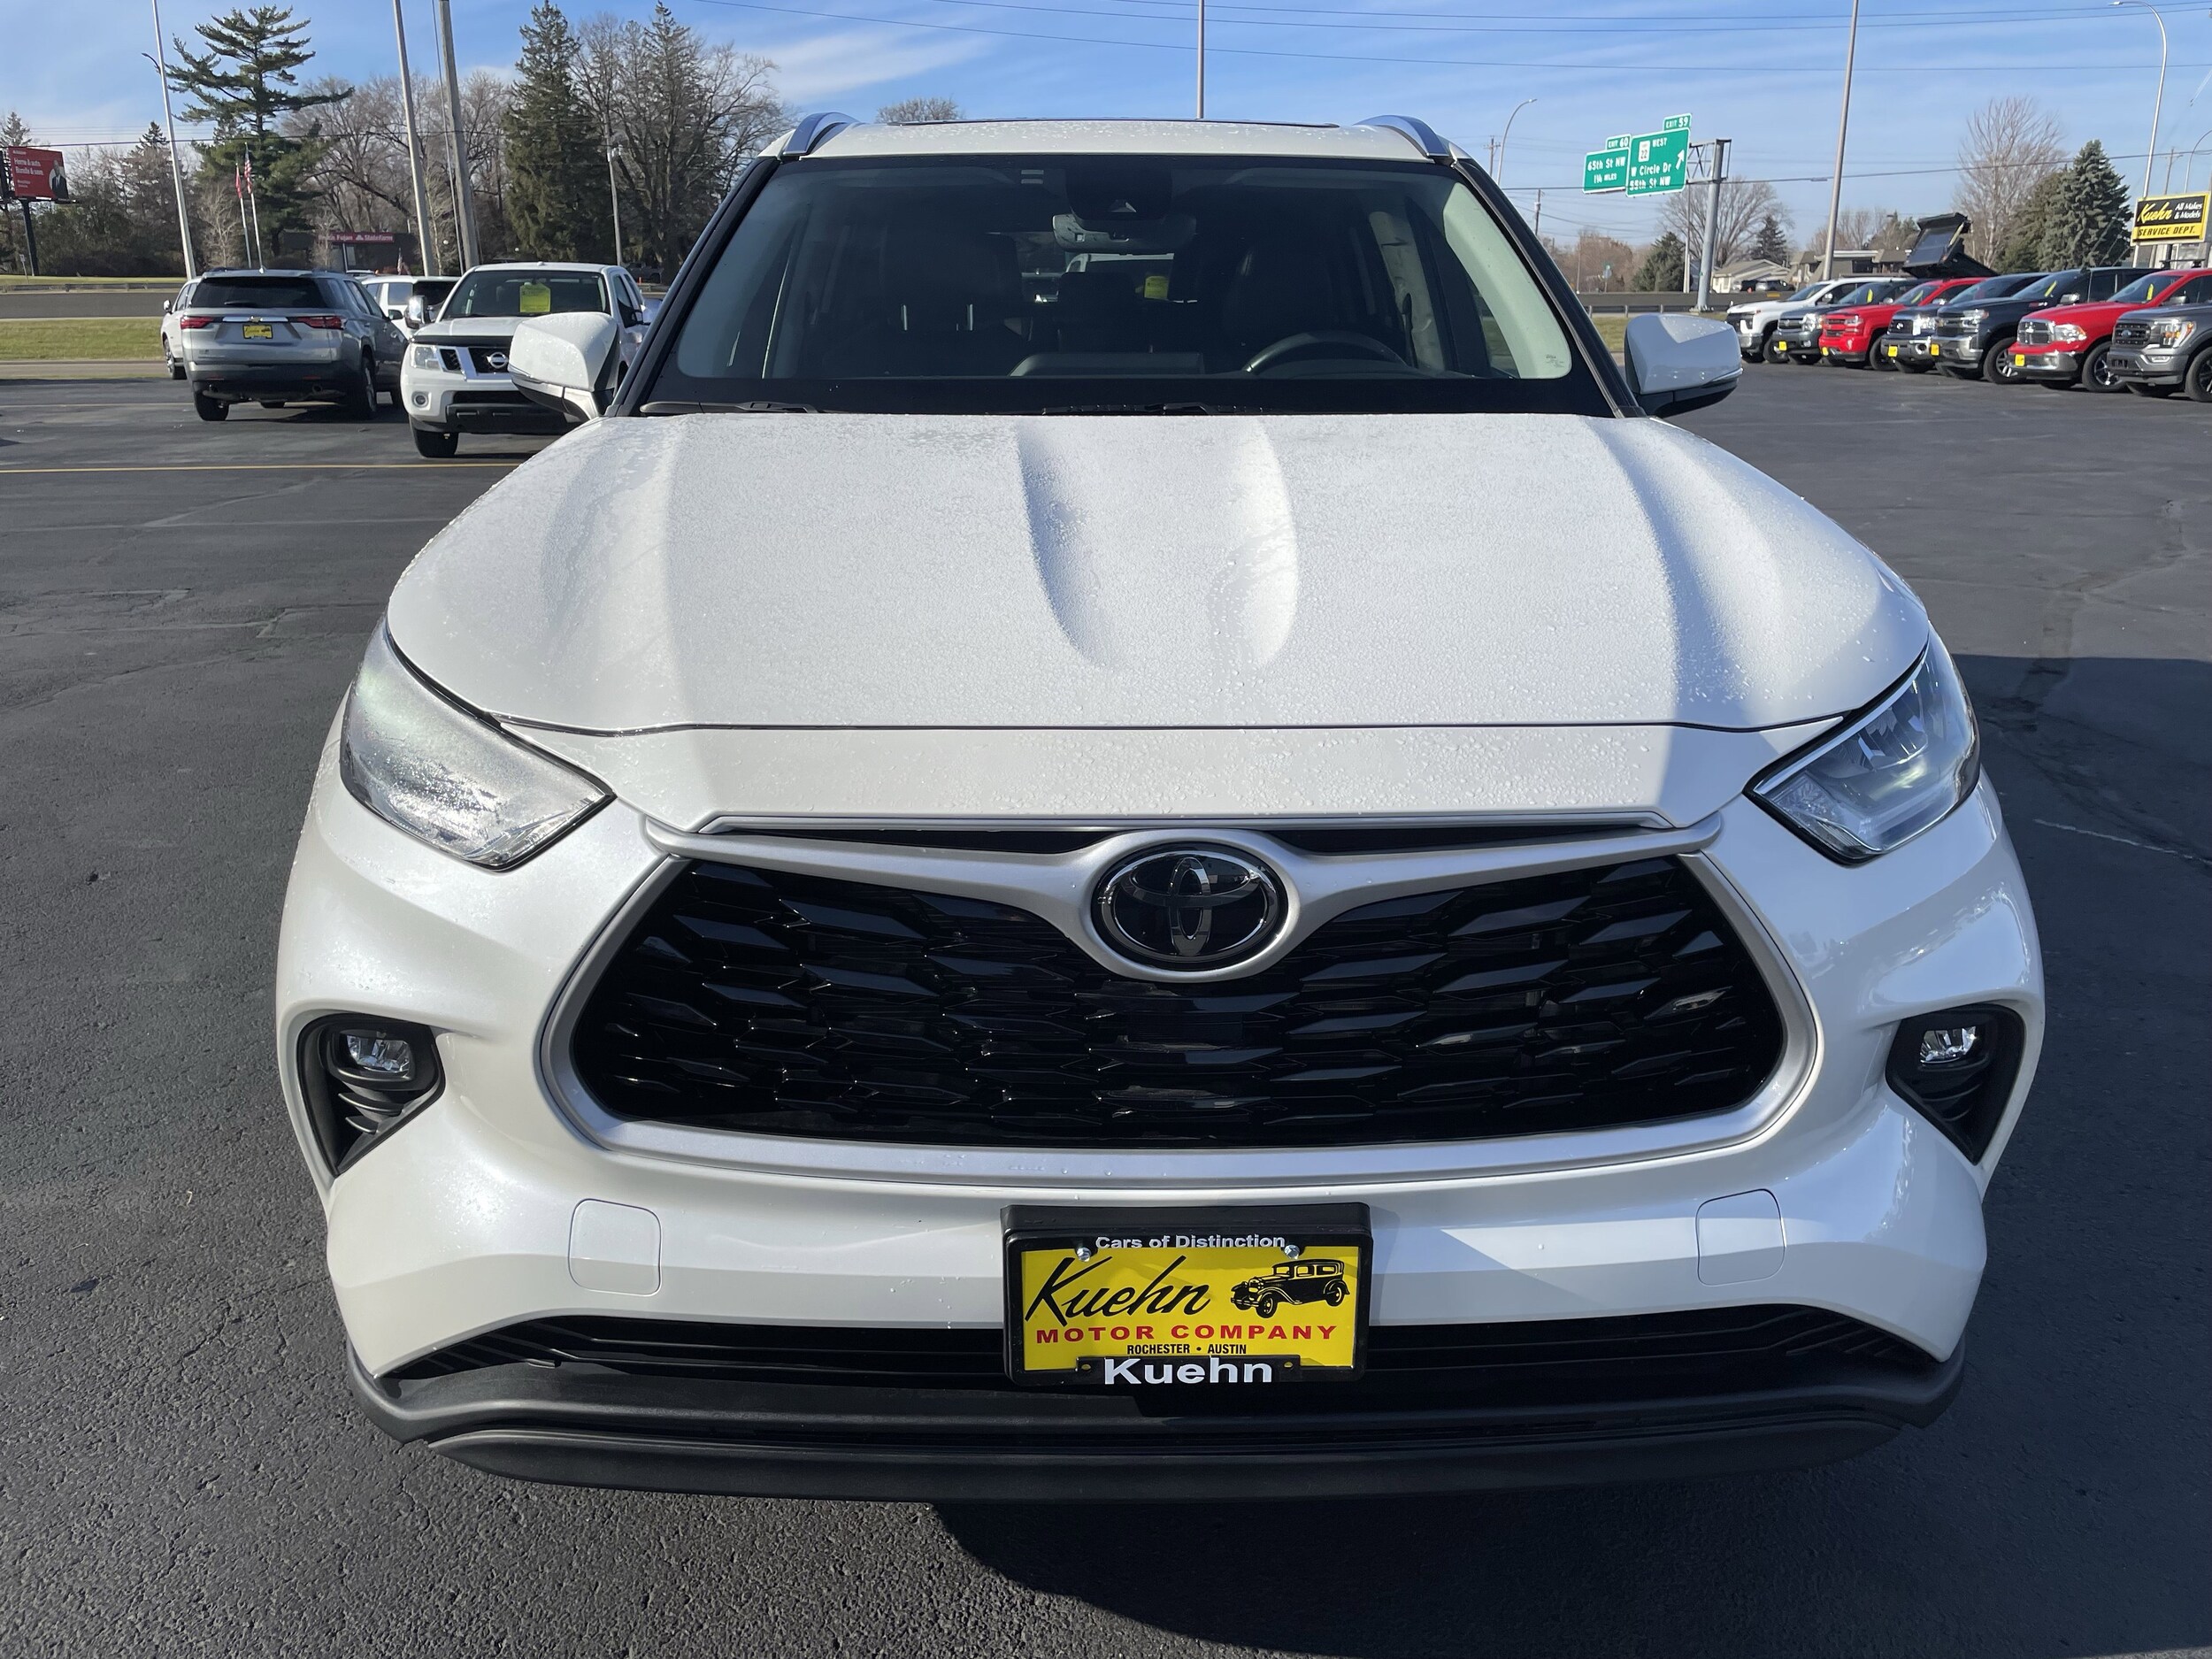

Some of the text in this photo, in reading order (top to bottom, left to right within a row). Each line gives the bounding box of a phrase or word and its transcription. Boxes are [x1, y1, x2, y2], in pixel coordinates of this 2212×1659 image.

[1665, 117, 1688, 129] EXIT 59
[1608, 137, 1628, 149] EXIT 60
[1652, 138, 1667, 148] WEST
[1640, 149, 1647, 159] 22
[1587, 156, 1626, 172] 65th St NW
[1631, 163, 1671, 177] W Circle Dr
[1629, 176, 1671, 191] 55th St NW
[2137, 202, 2173, 224] Kuehn
[2175, 202, 2185, 211] All
[2138, 225, 2195, 237] SERVICE DEPT.
[1094, 1233, 1286, 1249] Cars of Distinction
[1024, 1255, 1211, 1327] Kuehn
[1036, 1324, 1338, 1344] MOTOR COMPANY
[1127, 1343, 1247, 1356] ROCHESTER AUSTIN
[1104, 1357, 1273, 1386] Kuehn
